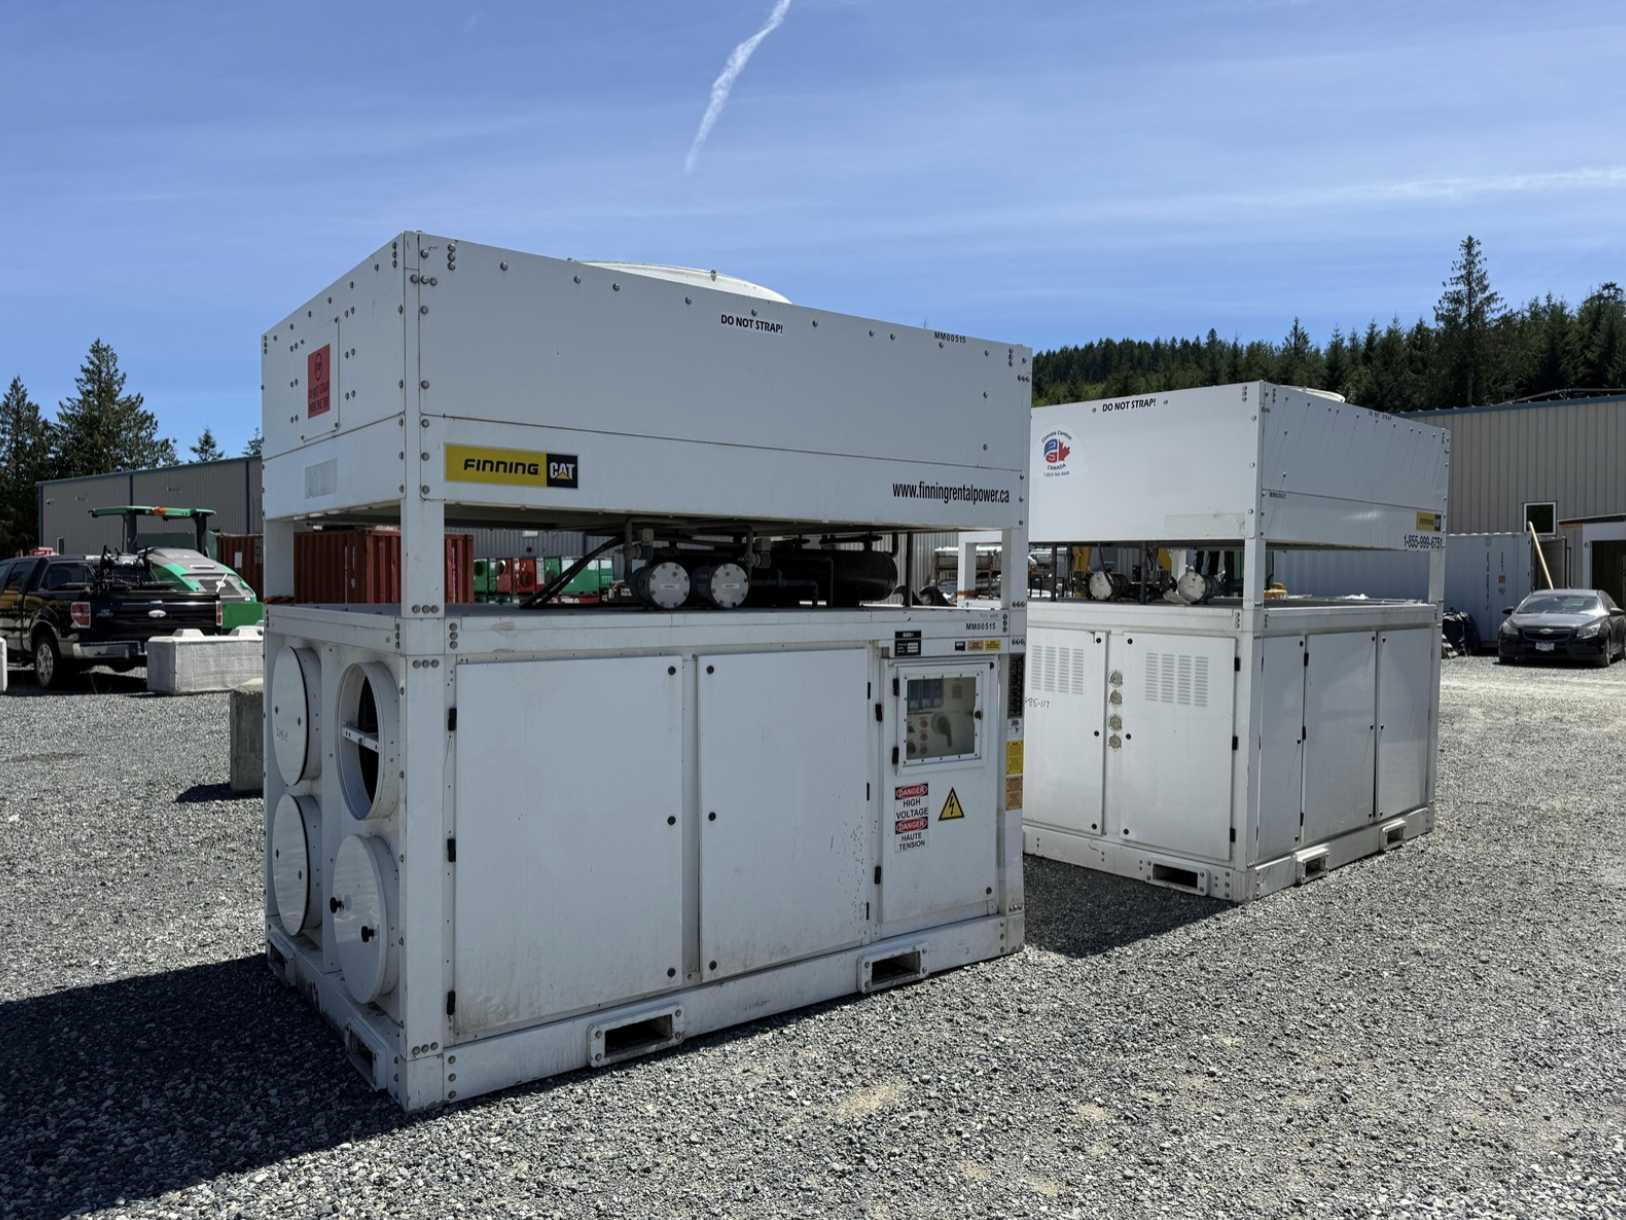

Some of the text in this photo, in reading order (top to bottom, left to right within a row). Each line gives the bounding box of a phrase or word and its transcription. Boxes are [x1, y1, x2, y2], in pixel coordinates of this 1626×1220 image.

[721, 314, 783, 334] DO NOT STRAP!
[934, 331, 966, 344] MM00515
[1102, 398, 1156, 412] DO NOT STRAP!
[463, 458, 575, 480] FINNING CAT
[892, 480, 1010, 505] www.finningrentalpower.ca
[965, 622, 996, 631] MM00515
[899, 786, 925, 797] DANGER
[903, 798, 920, 808] HIGH
[896, 807, 928, 820] VOLTAGE
[899, 820, 925, 831] DANGER
[901, 832, 922, 842] HAUTE
[899, 840, 925, 851] TENSION
